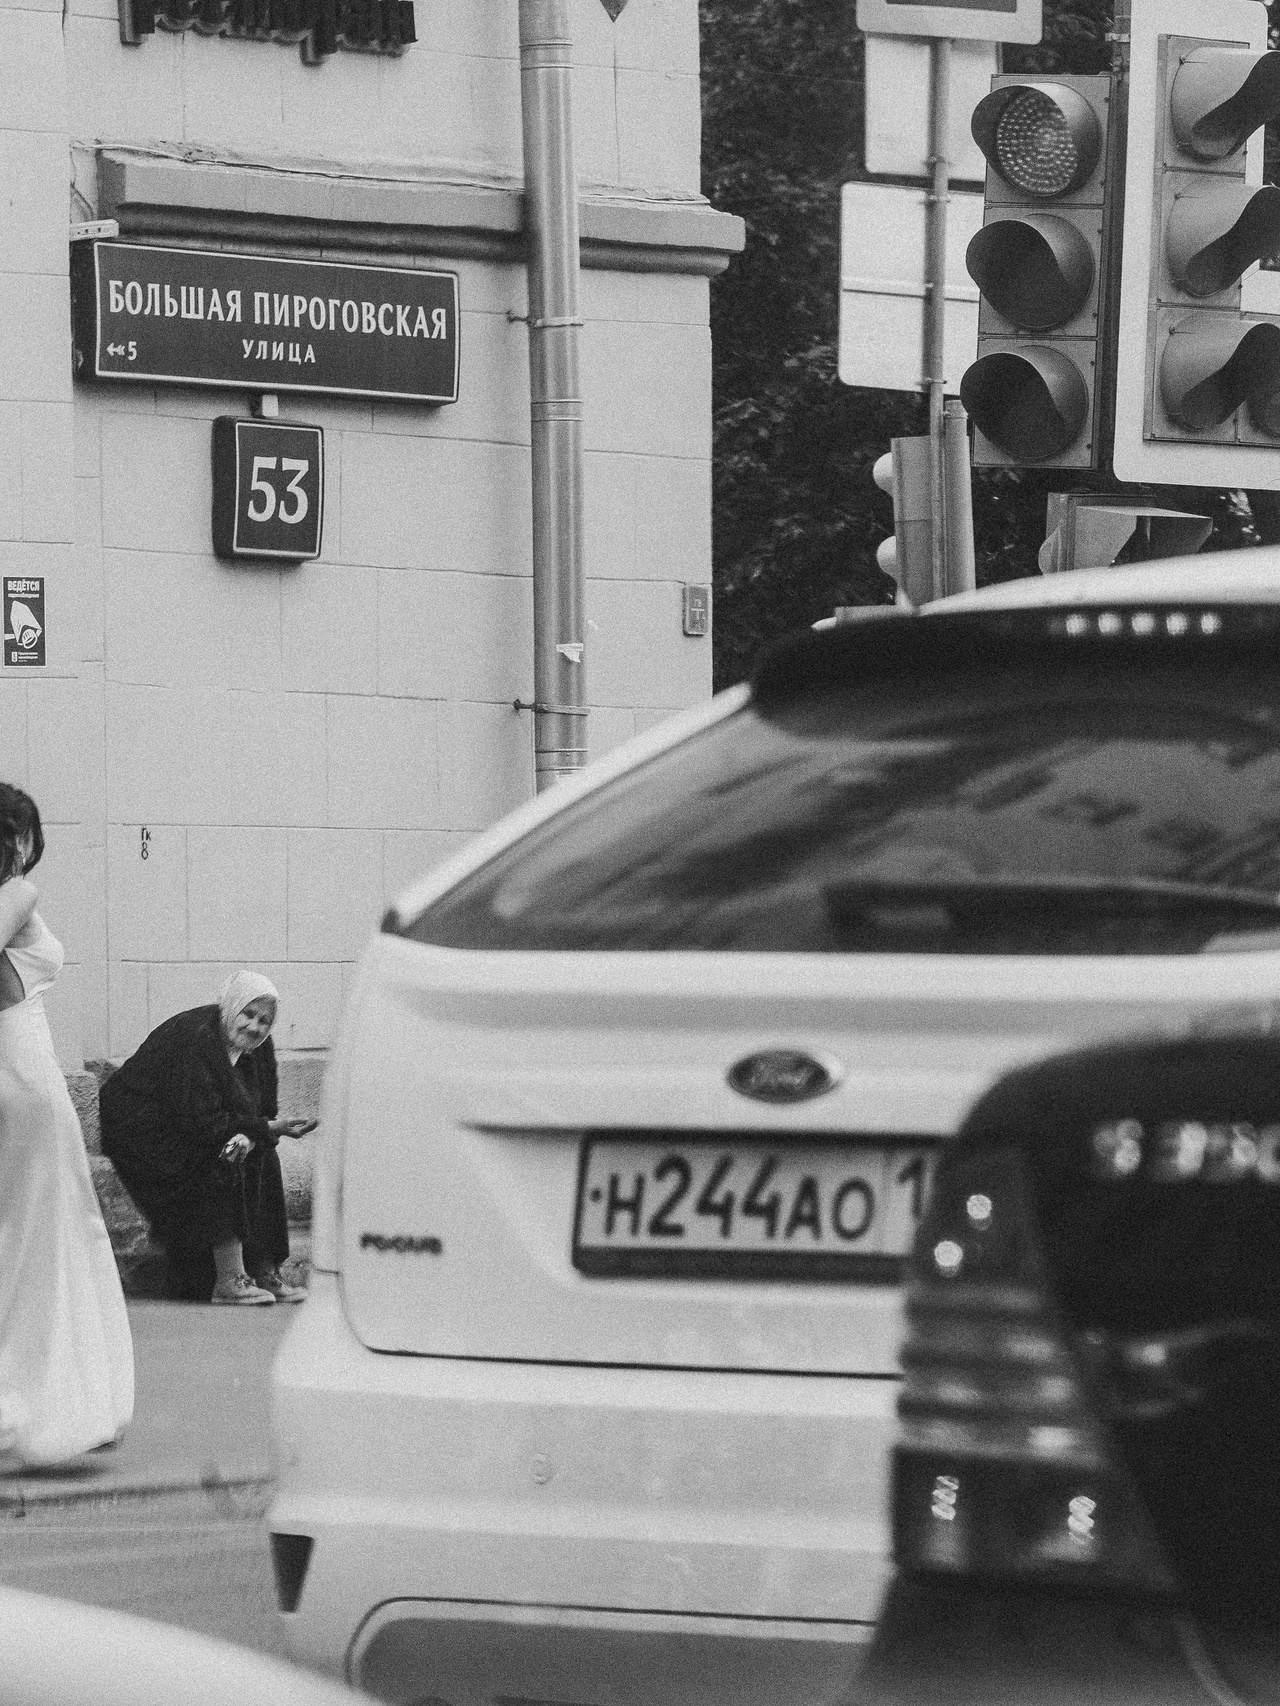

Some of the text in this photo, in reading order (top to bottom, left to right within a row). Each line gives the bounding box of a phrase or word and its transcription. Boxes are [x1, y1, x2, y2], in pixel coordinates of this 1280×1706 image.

[108, 280, 447, 340] БОЛЬШАЯ ПИРОГОВСКАЯ
[127, 340, 138, 361] 5
[242, 339, 316, 365] УЛИЦА
[247, 456, 310, 524] 53
